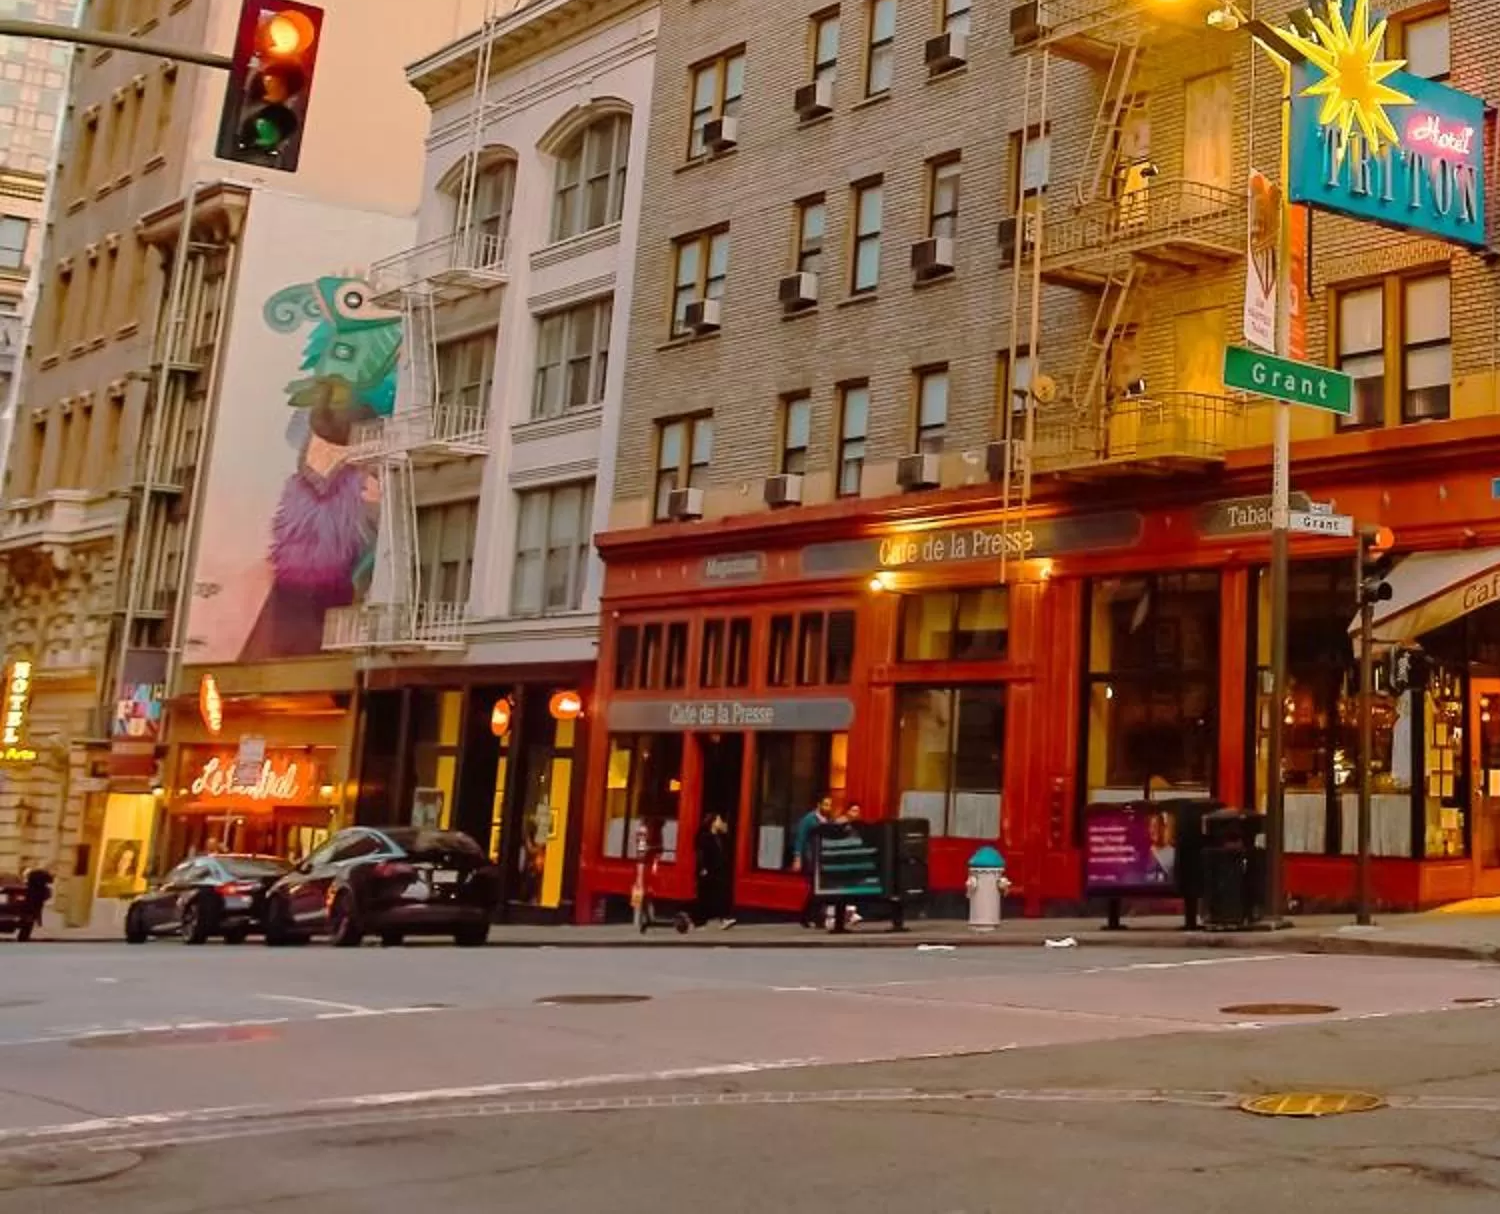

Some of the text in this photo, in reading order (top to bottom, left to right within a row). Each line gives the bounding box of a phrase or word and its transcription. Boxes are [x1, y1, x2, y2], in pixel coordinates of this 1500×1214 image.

[1412, 115, 1475, 156] Hotel
[1317, 123, 1477, 225] TRITON
[1252, 362, 1328, 399] Grant
[1303, 515, 1340, 531] Grant
[923, 533, 945, 562] de
[950, 531, 967, 559] la
[971, 528, 1035, 557] Presse
[700, 703, 716, 725] de
[717, 703, 730, 725] la
[733, 702, 774, 725] Presse
